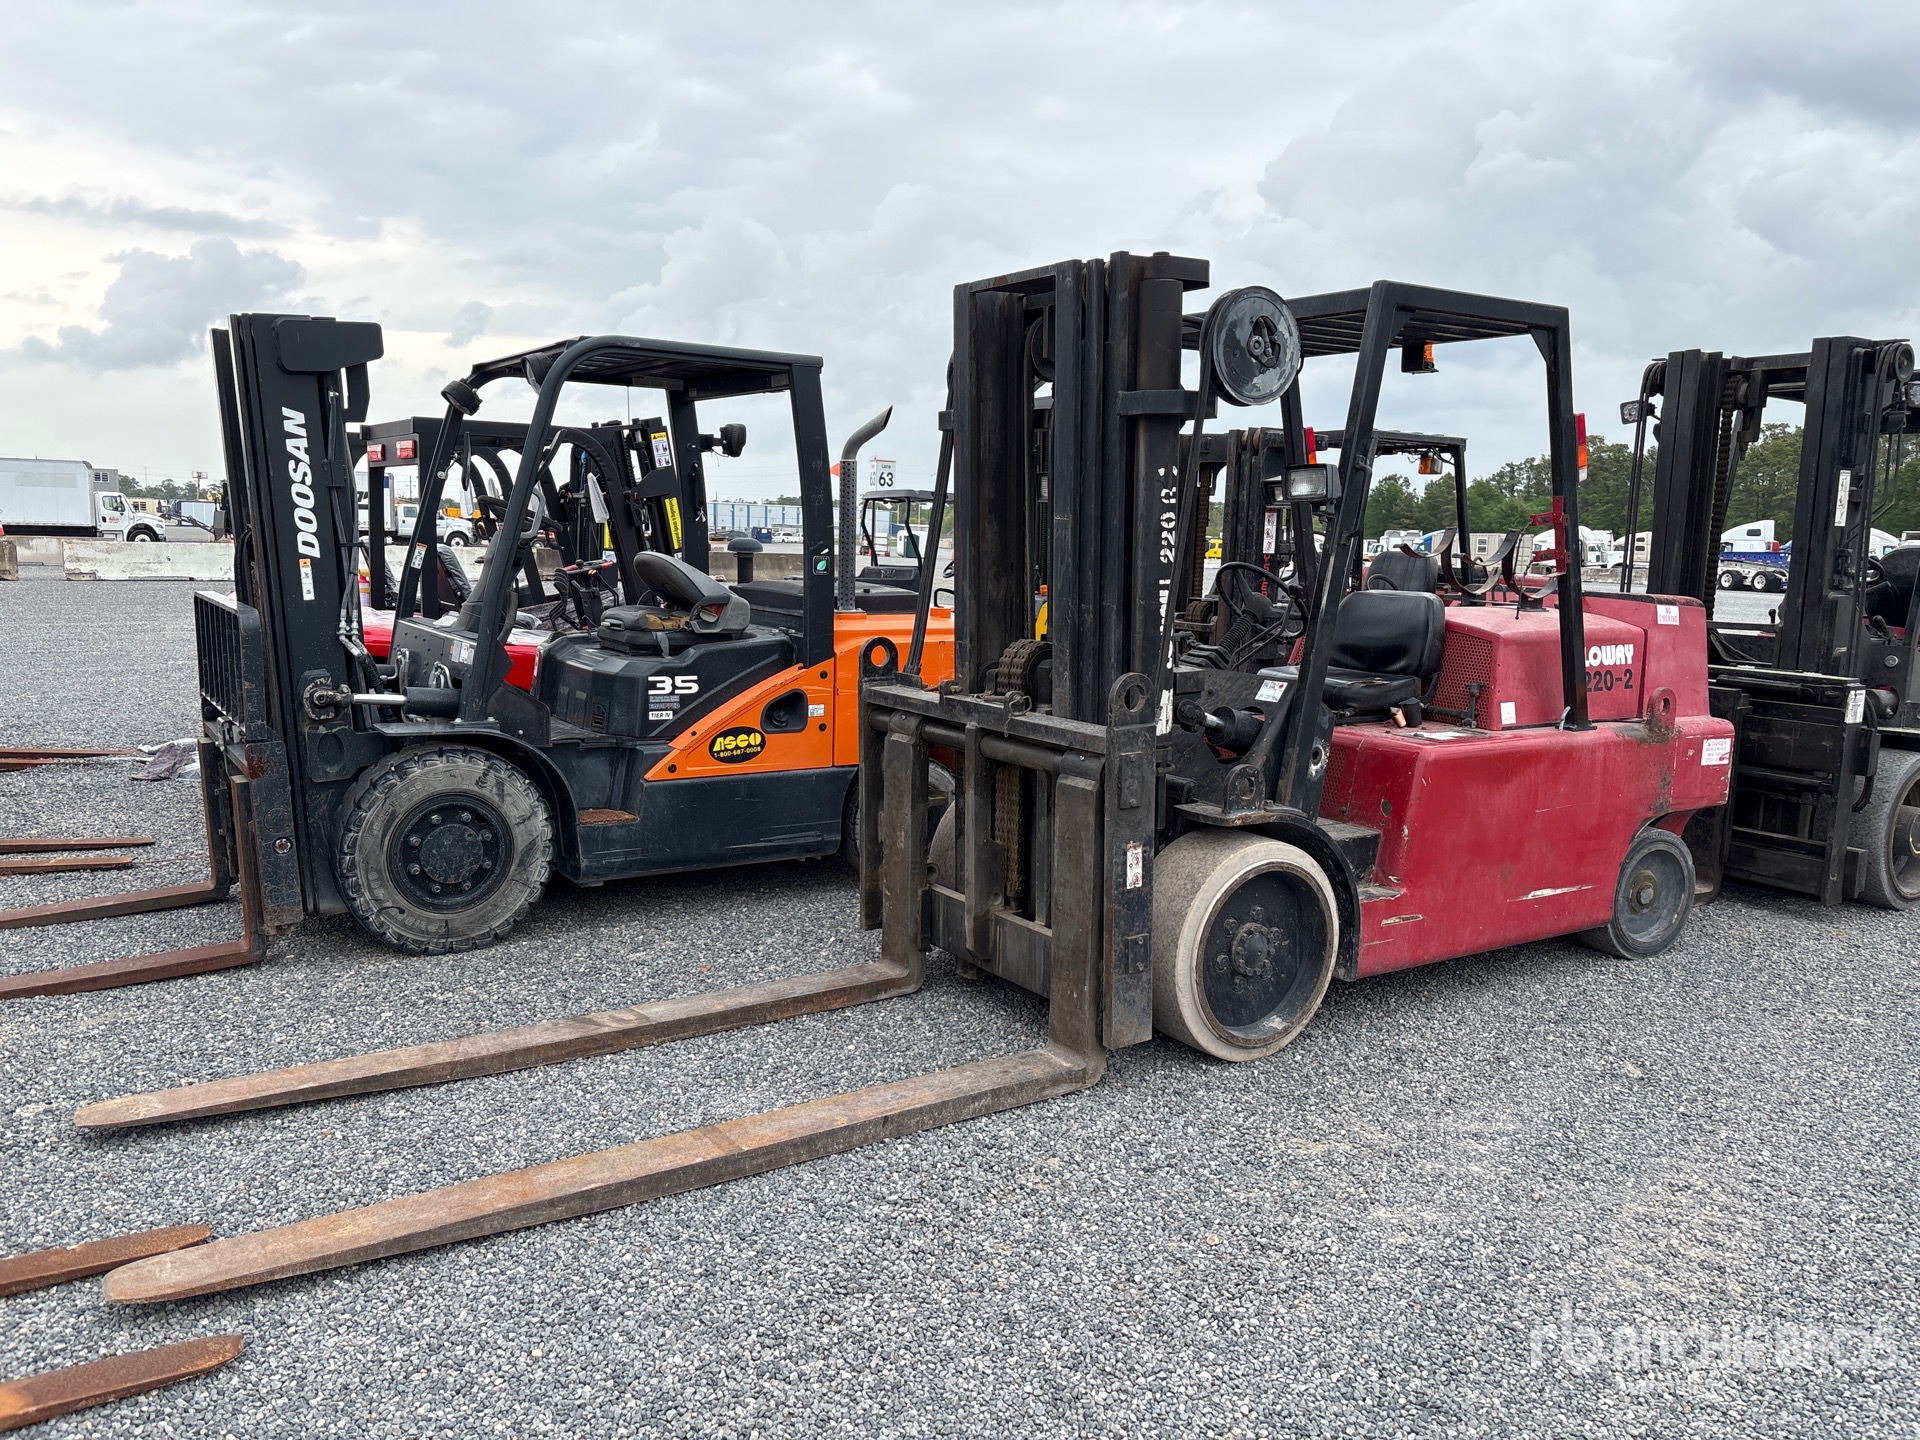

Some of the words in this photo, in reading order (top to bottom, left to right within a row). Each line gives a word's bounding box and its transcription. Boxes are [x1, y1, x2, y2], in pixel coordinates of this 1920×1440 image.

[281, 406, 321, 558] DOOSAN
[879, 471, 894, 487] 63
[1659, 614, 1678, 623] SMOKING
[1665, 606, 1672, 615] NO
[647, 675, 700, 695] 35
[712, 732, 762, 752] ASCO
